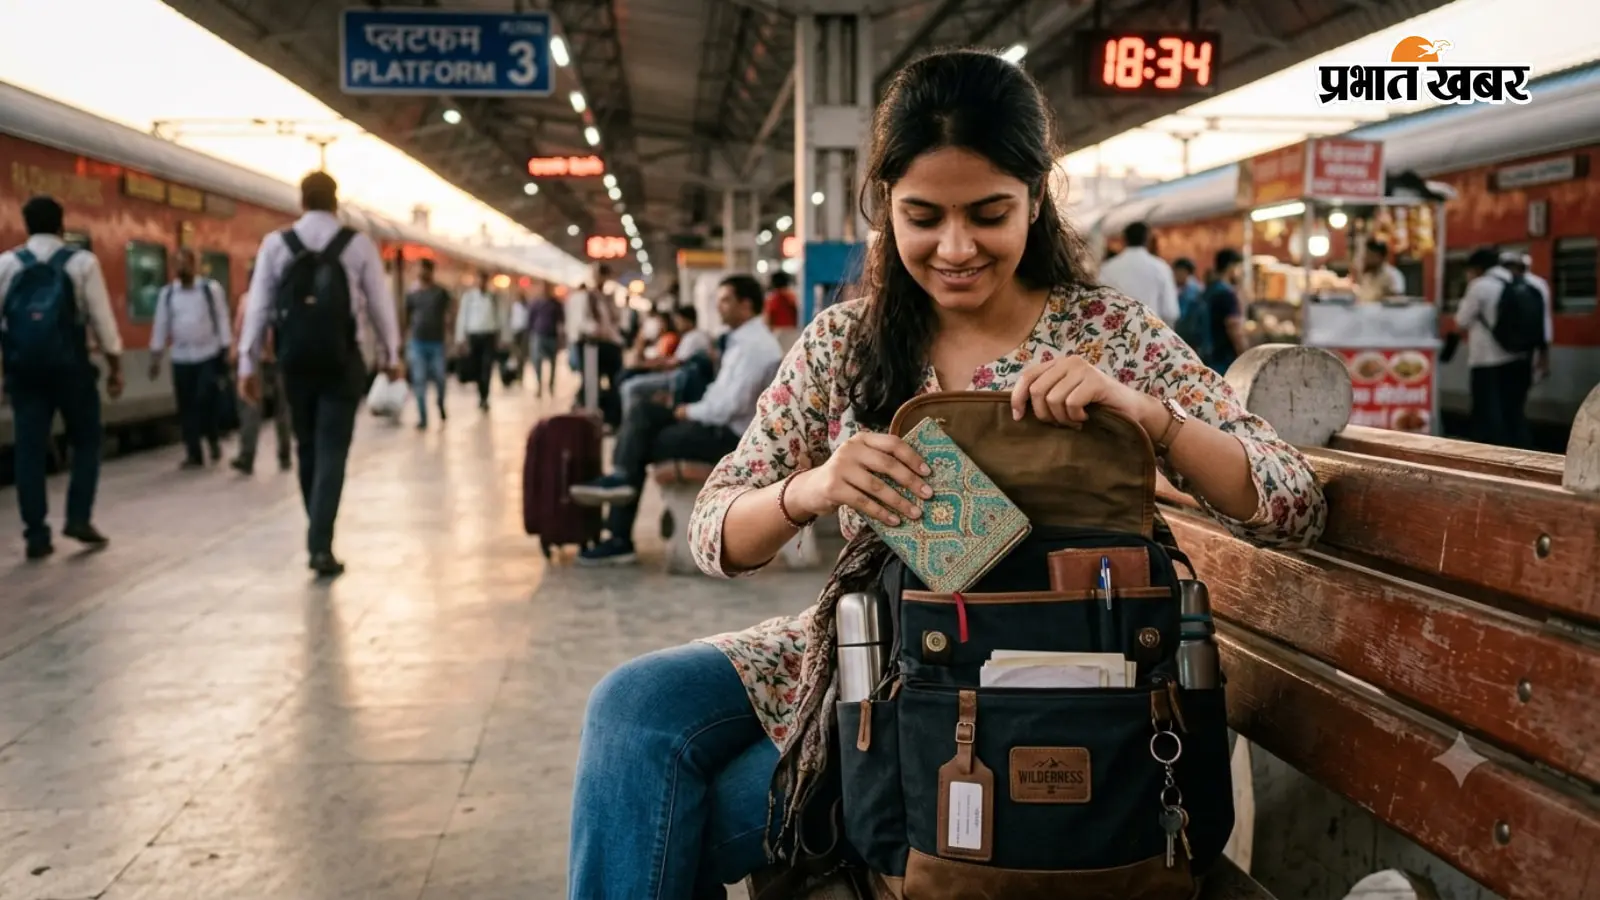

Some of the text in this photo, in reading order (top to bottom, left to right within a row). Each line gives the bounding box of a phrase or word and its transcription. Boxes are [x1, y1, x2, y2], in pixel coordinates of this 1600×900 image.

[350, 40, 539, 86] PLATFORM 3
[1103, 36, 1212, 88] 18:34
[1017, 769, 1084, 785] WILDERNESS
